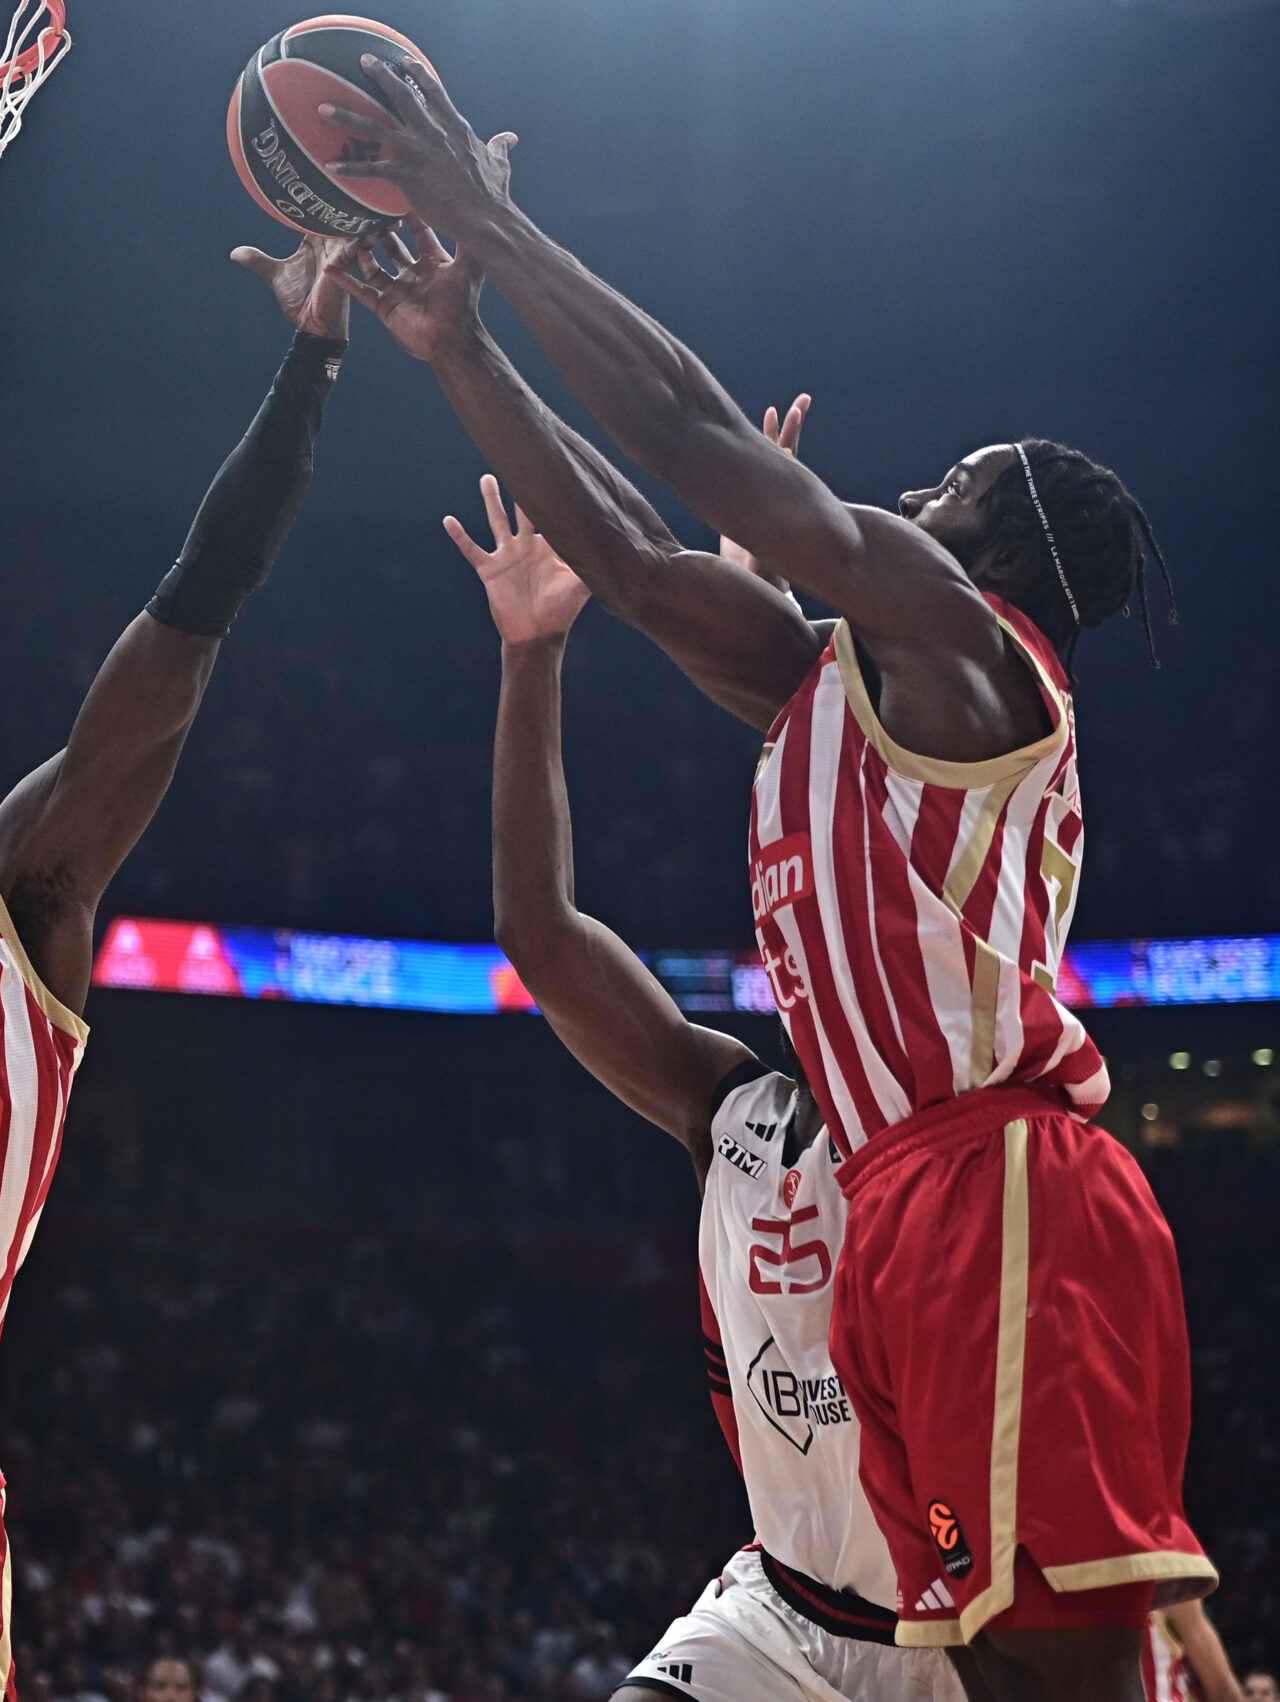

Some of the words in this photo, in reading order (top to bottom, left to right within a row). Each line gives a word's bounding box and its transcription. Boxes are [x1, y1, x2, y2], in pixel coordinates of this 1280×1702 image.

[1027, 478, 1038, 499] THREE
[1033, 499, 1050, 530] STRIPES
[1051, 546, 1058, 557] LA
[1055, 558, 1069, 588] MARQUE
